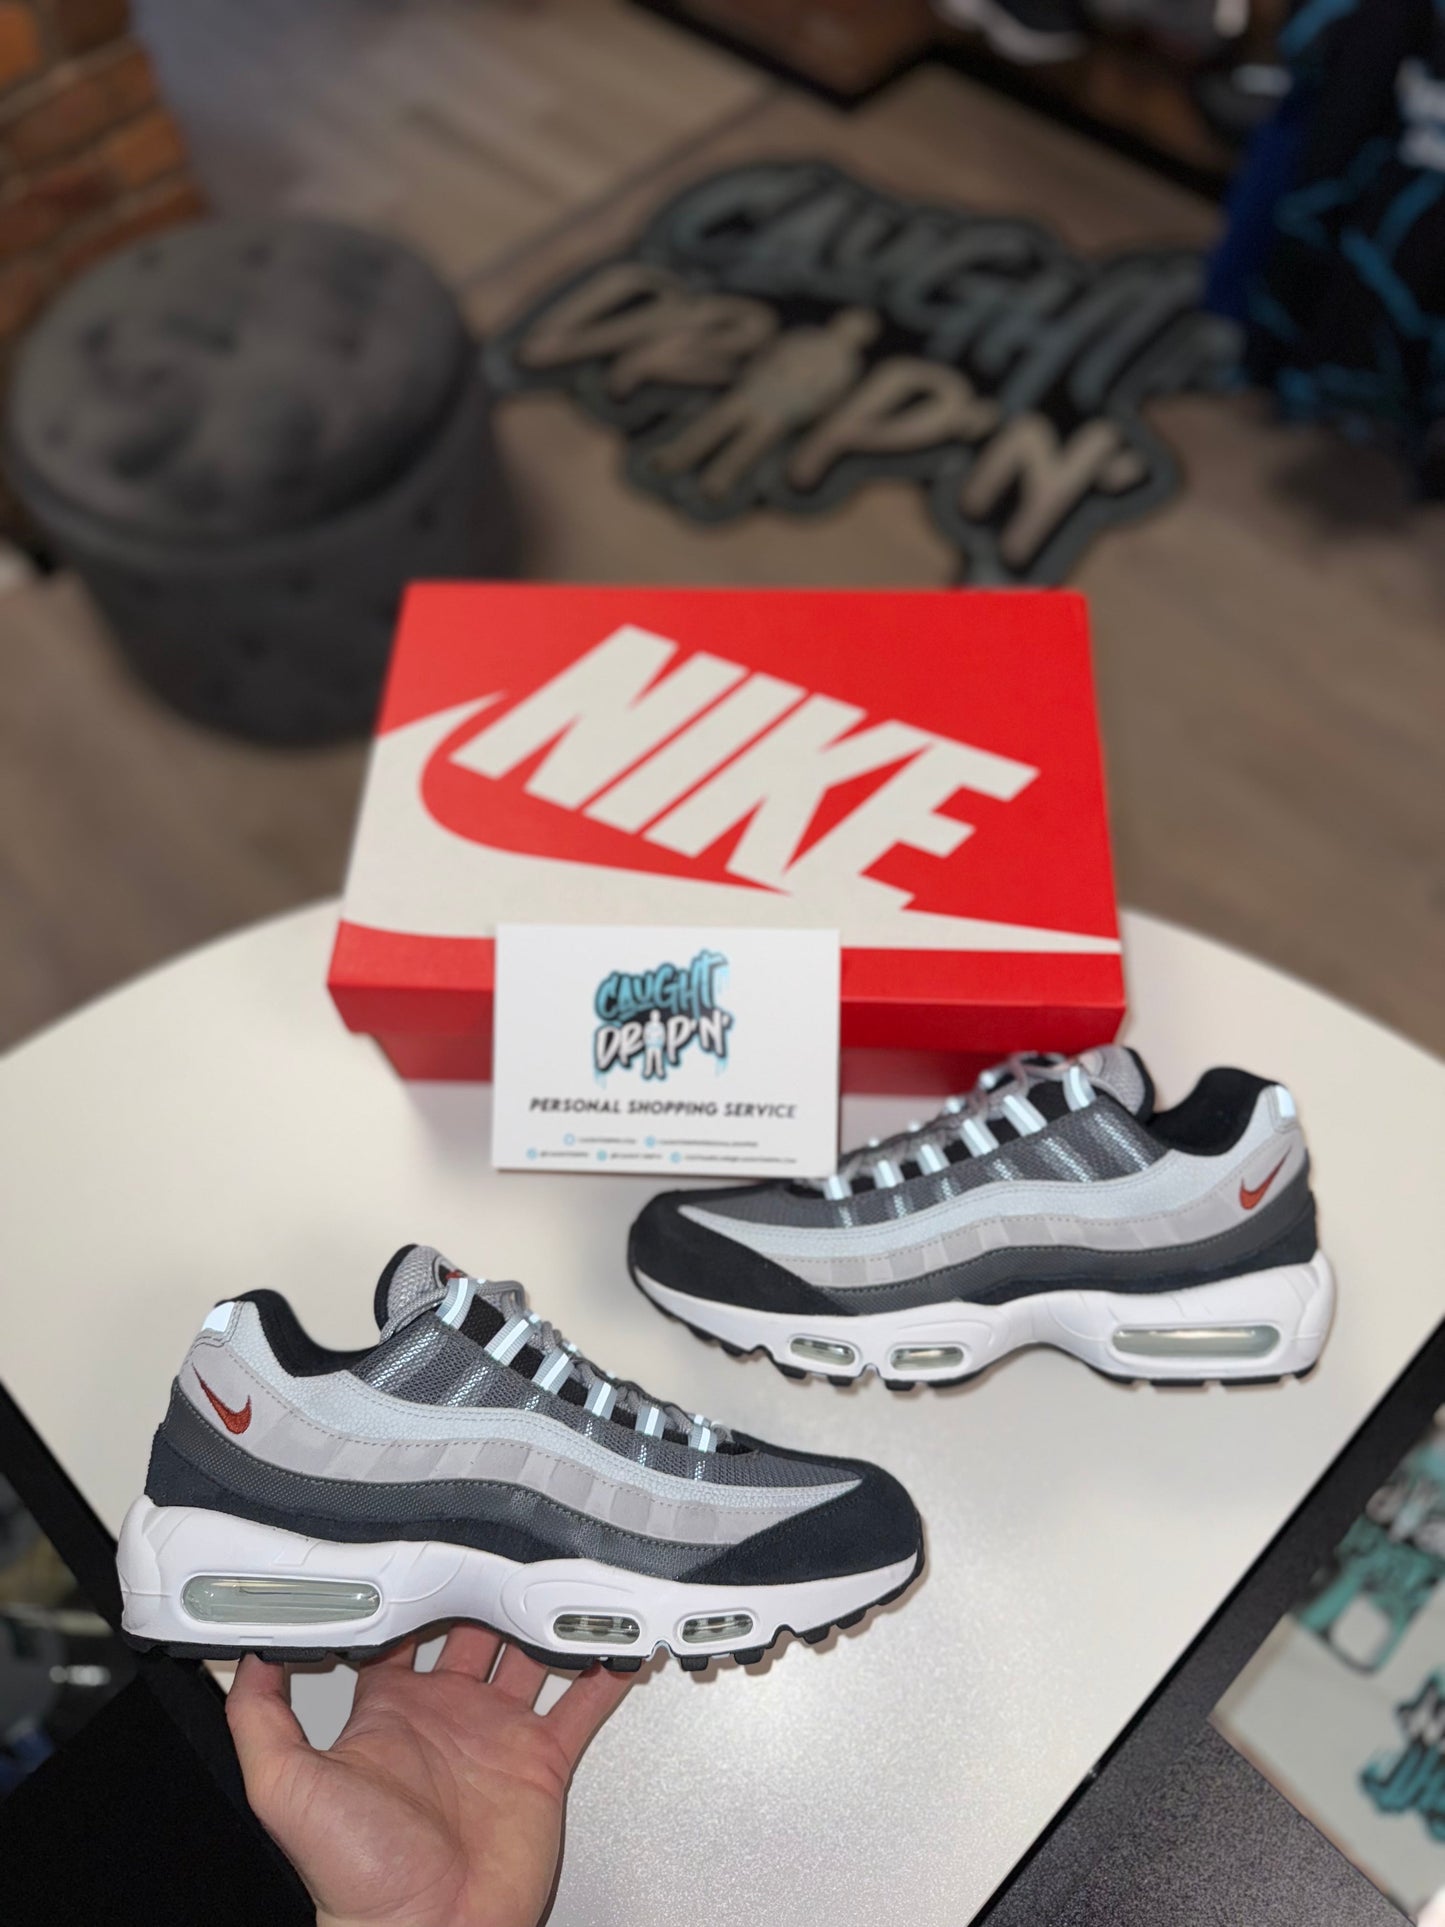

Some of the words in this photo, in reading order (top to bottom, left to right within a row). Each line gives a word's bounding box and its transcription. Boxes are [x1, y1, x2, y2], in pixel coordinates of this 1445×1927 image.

[449, 624, 1040, 911] NIKE
[595, 949, 728, 1020] CAUGHT
[529, 1097, 621, 1115] PERSONAL
[627, 1100, 718, 1118] SHOPPING
[724, 1102, 797, 1120] SERVICE
